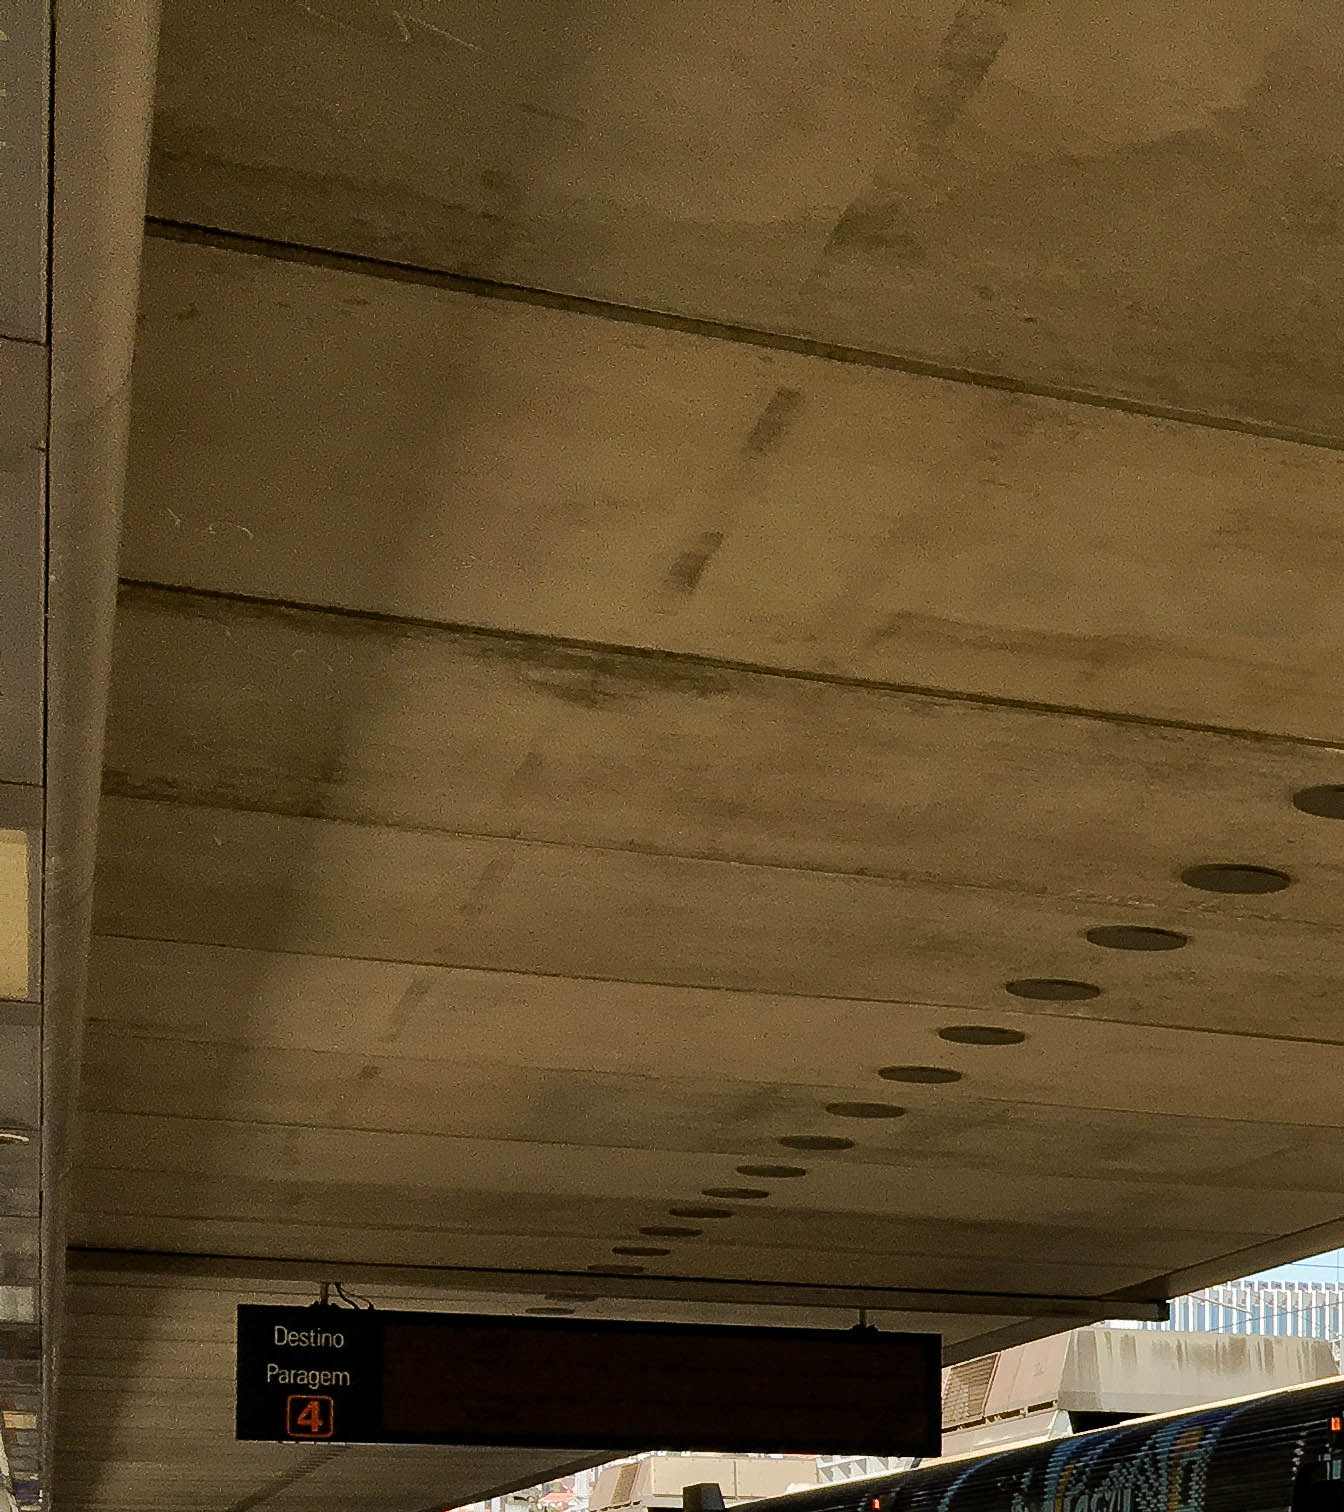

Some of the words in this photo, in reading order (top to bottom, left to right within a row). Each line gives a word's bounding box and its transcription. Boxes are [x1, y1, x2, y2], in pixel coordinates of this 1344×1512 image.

[274, 1325, 345, 1349] Destino
[266, 1364, 351, 1389] Paragem
[296, 1401, 323, 1433] 4
